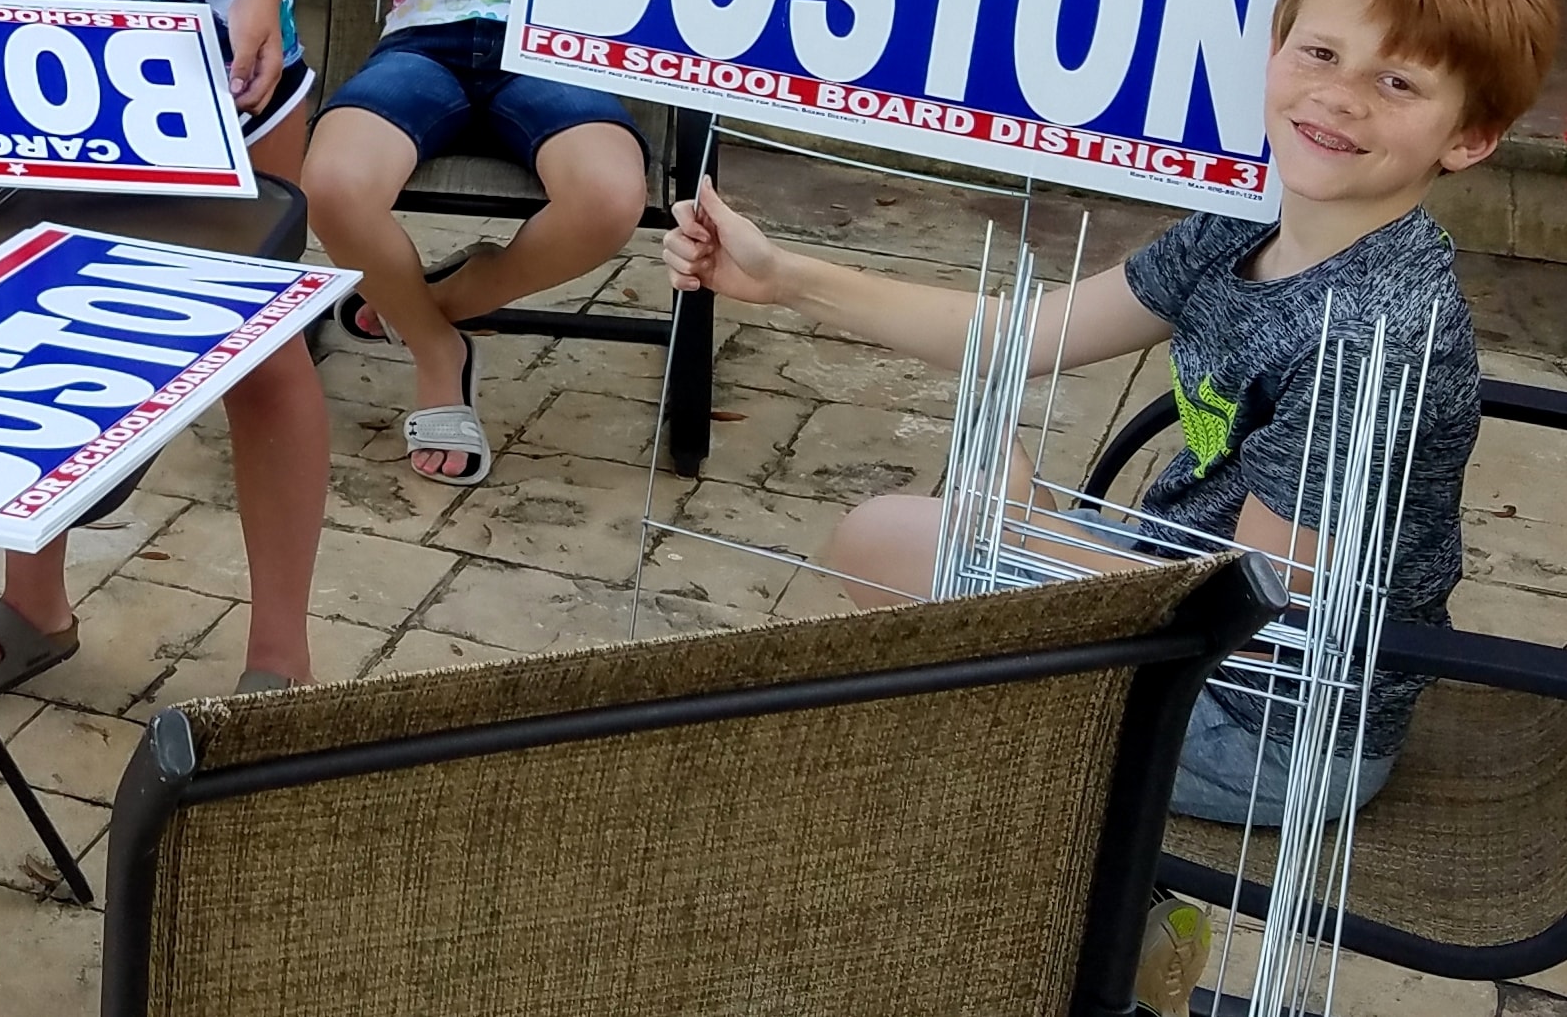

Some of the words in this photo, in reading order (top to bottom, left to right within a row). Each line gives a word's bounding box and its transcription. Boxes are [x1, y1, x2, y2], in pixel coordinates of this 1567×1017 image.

[124, 13, 196, 31] FOR
[526, 29, 610, 66] FOR
[622, 47, 801, 102] SCHOOL
[816, 83, 974, 136] BOARD
[989, 115, 1217, 181] DISTRICT
[1231, 162, 1259, 190] 3
[4, 470, 71, 519] FOR
[60, 407, 165, 478] SCHOOL
[158, 349, 233, 407] BOARD
[226, 283, 316, 348] DISTRICT
[307, 271, 331, 289] 3
